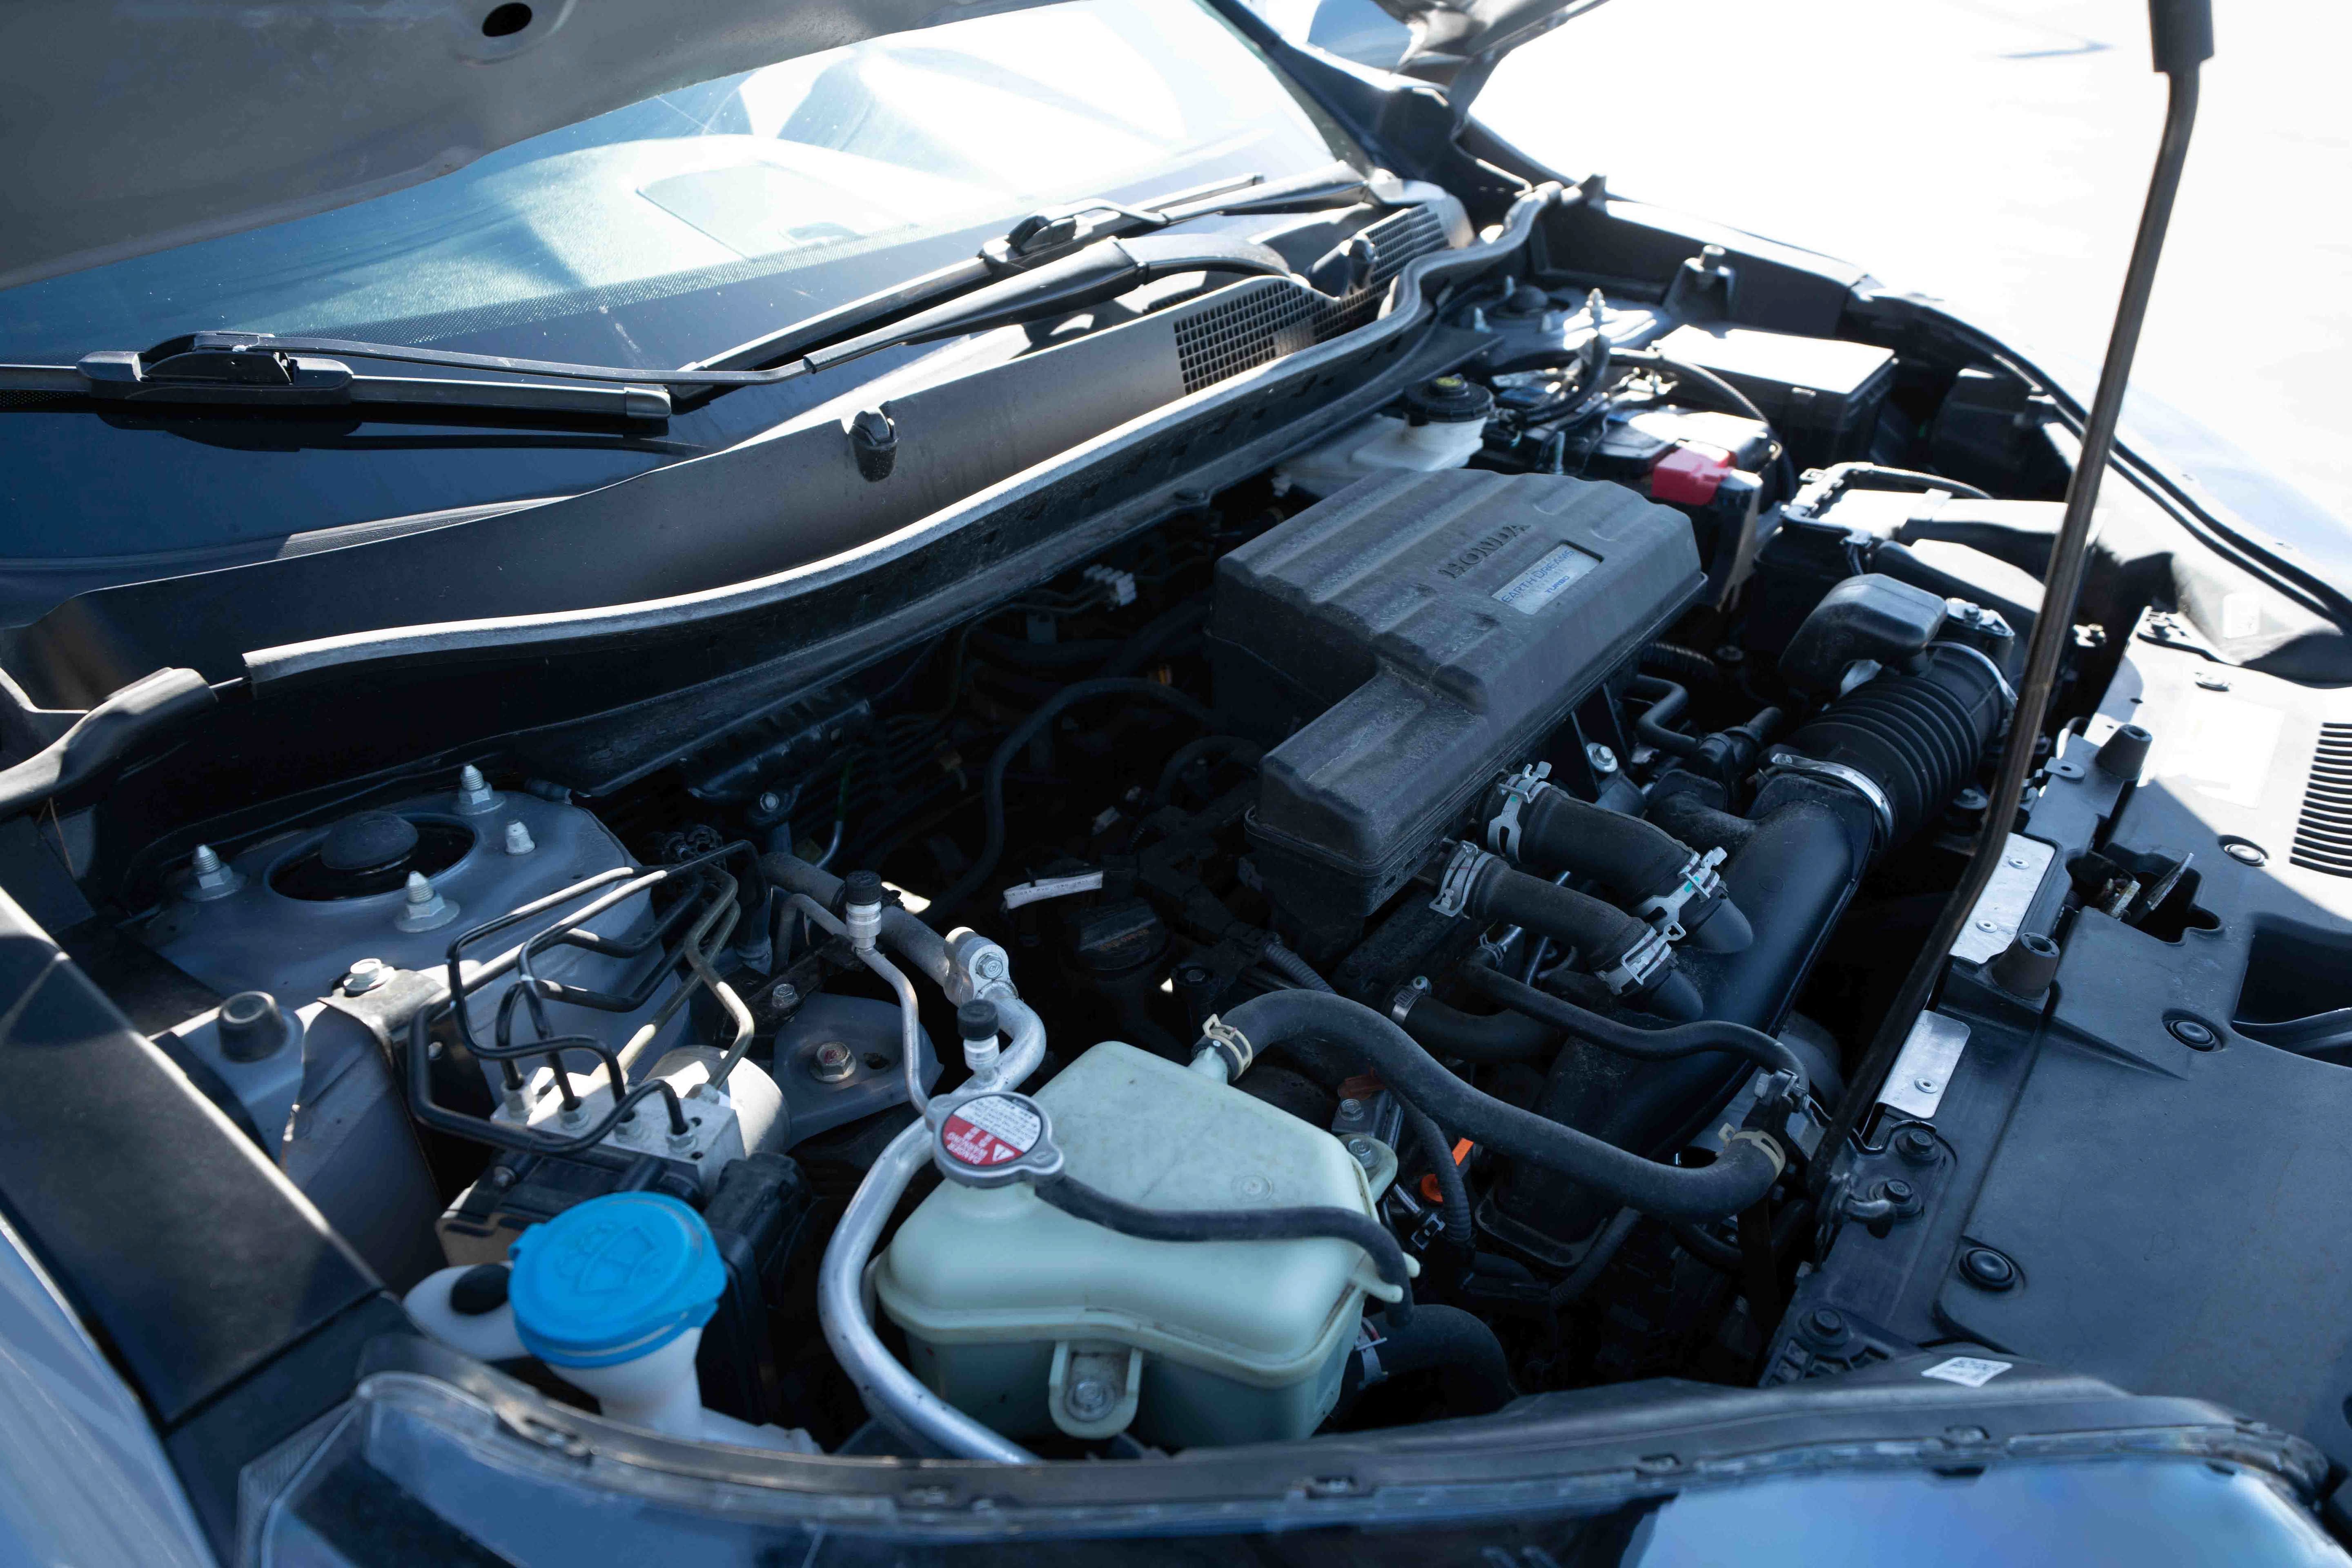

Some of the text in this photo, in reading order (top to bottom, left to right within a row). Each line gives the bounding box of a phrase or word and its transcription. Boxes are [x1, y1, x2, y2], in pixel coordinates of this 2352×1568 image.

[1438, 524, 1531, 579] HONDA
[1501, 549, 1575, 604] EARTH DREAMS
[1544, 575, 1570, 594] TURBO
